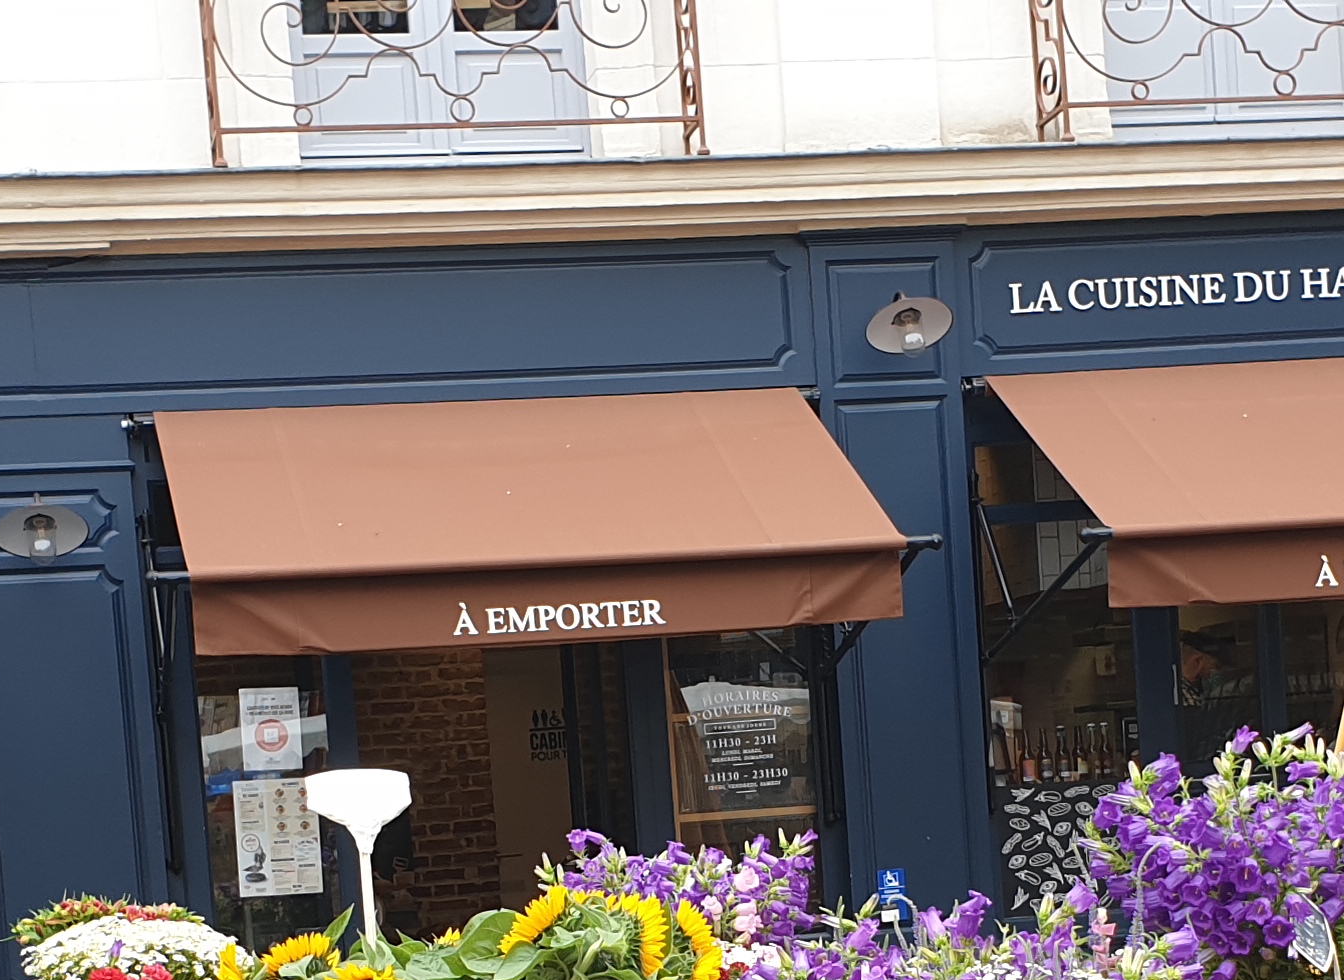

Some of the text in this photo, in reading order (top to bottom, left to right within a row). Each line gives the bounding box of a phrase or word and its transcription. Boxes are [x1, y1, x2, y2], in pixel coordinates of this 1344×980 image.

[1009, 282, 1063, 314] LA
[1068, 273, 1227, 311] CUISINE
[1233, 270, 1292, 303] DU
[1315, 555, 1338, 588] À
[453, 599, 666, 636] À EMPORTER
[687, 690, 793, 726] HORAIRES D'OUVERTURE
[706, 738, 741, 749] 11H30
[753, 735, 777, 745] 23H
[704, 772, 740, 783] 11H30
[752, 768, 789, 779] 23H30
